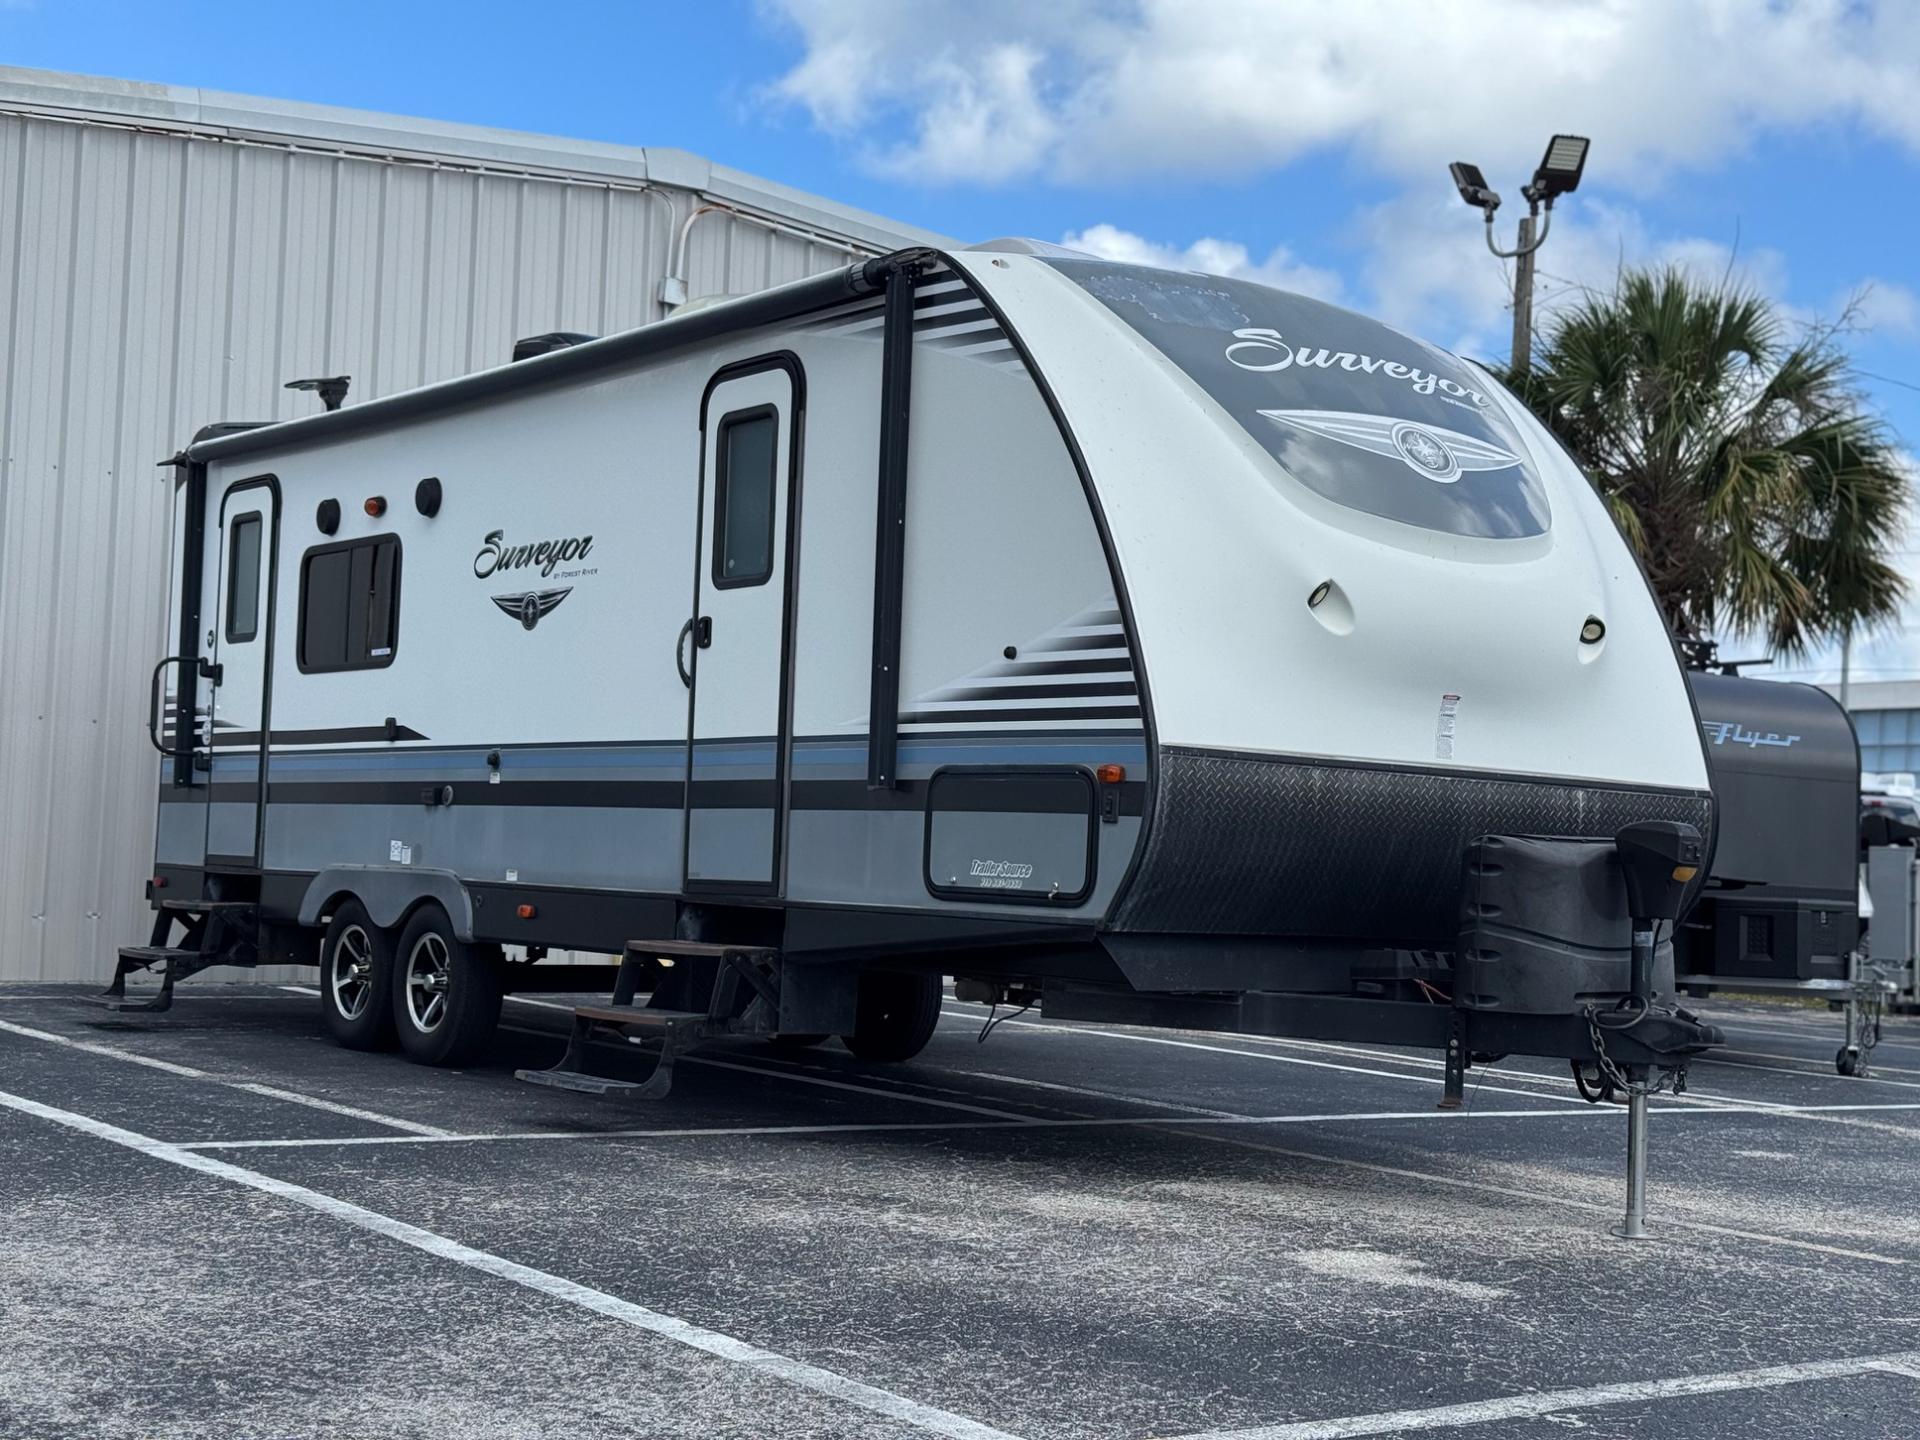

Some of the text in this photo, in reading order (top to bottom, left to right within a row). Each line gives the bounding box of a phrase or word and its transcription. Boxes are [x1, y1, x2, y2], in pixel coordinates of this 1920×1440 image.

[1225, 328, 1488, 408] Surveyor
[473, 529, 594, 579] Surveyor
[1706, 721, 1801, 748] Flyer
[970, 859, 1033, 878] Trailer Source
